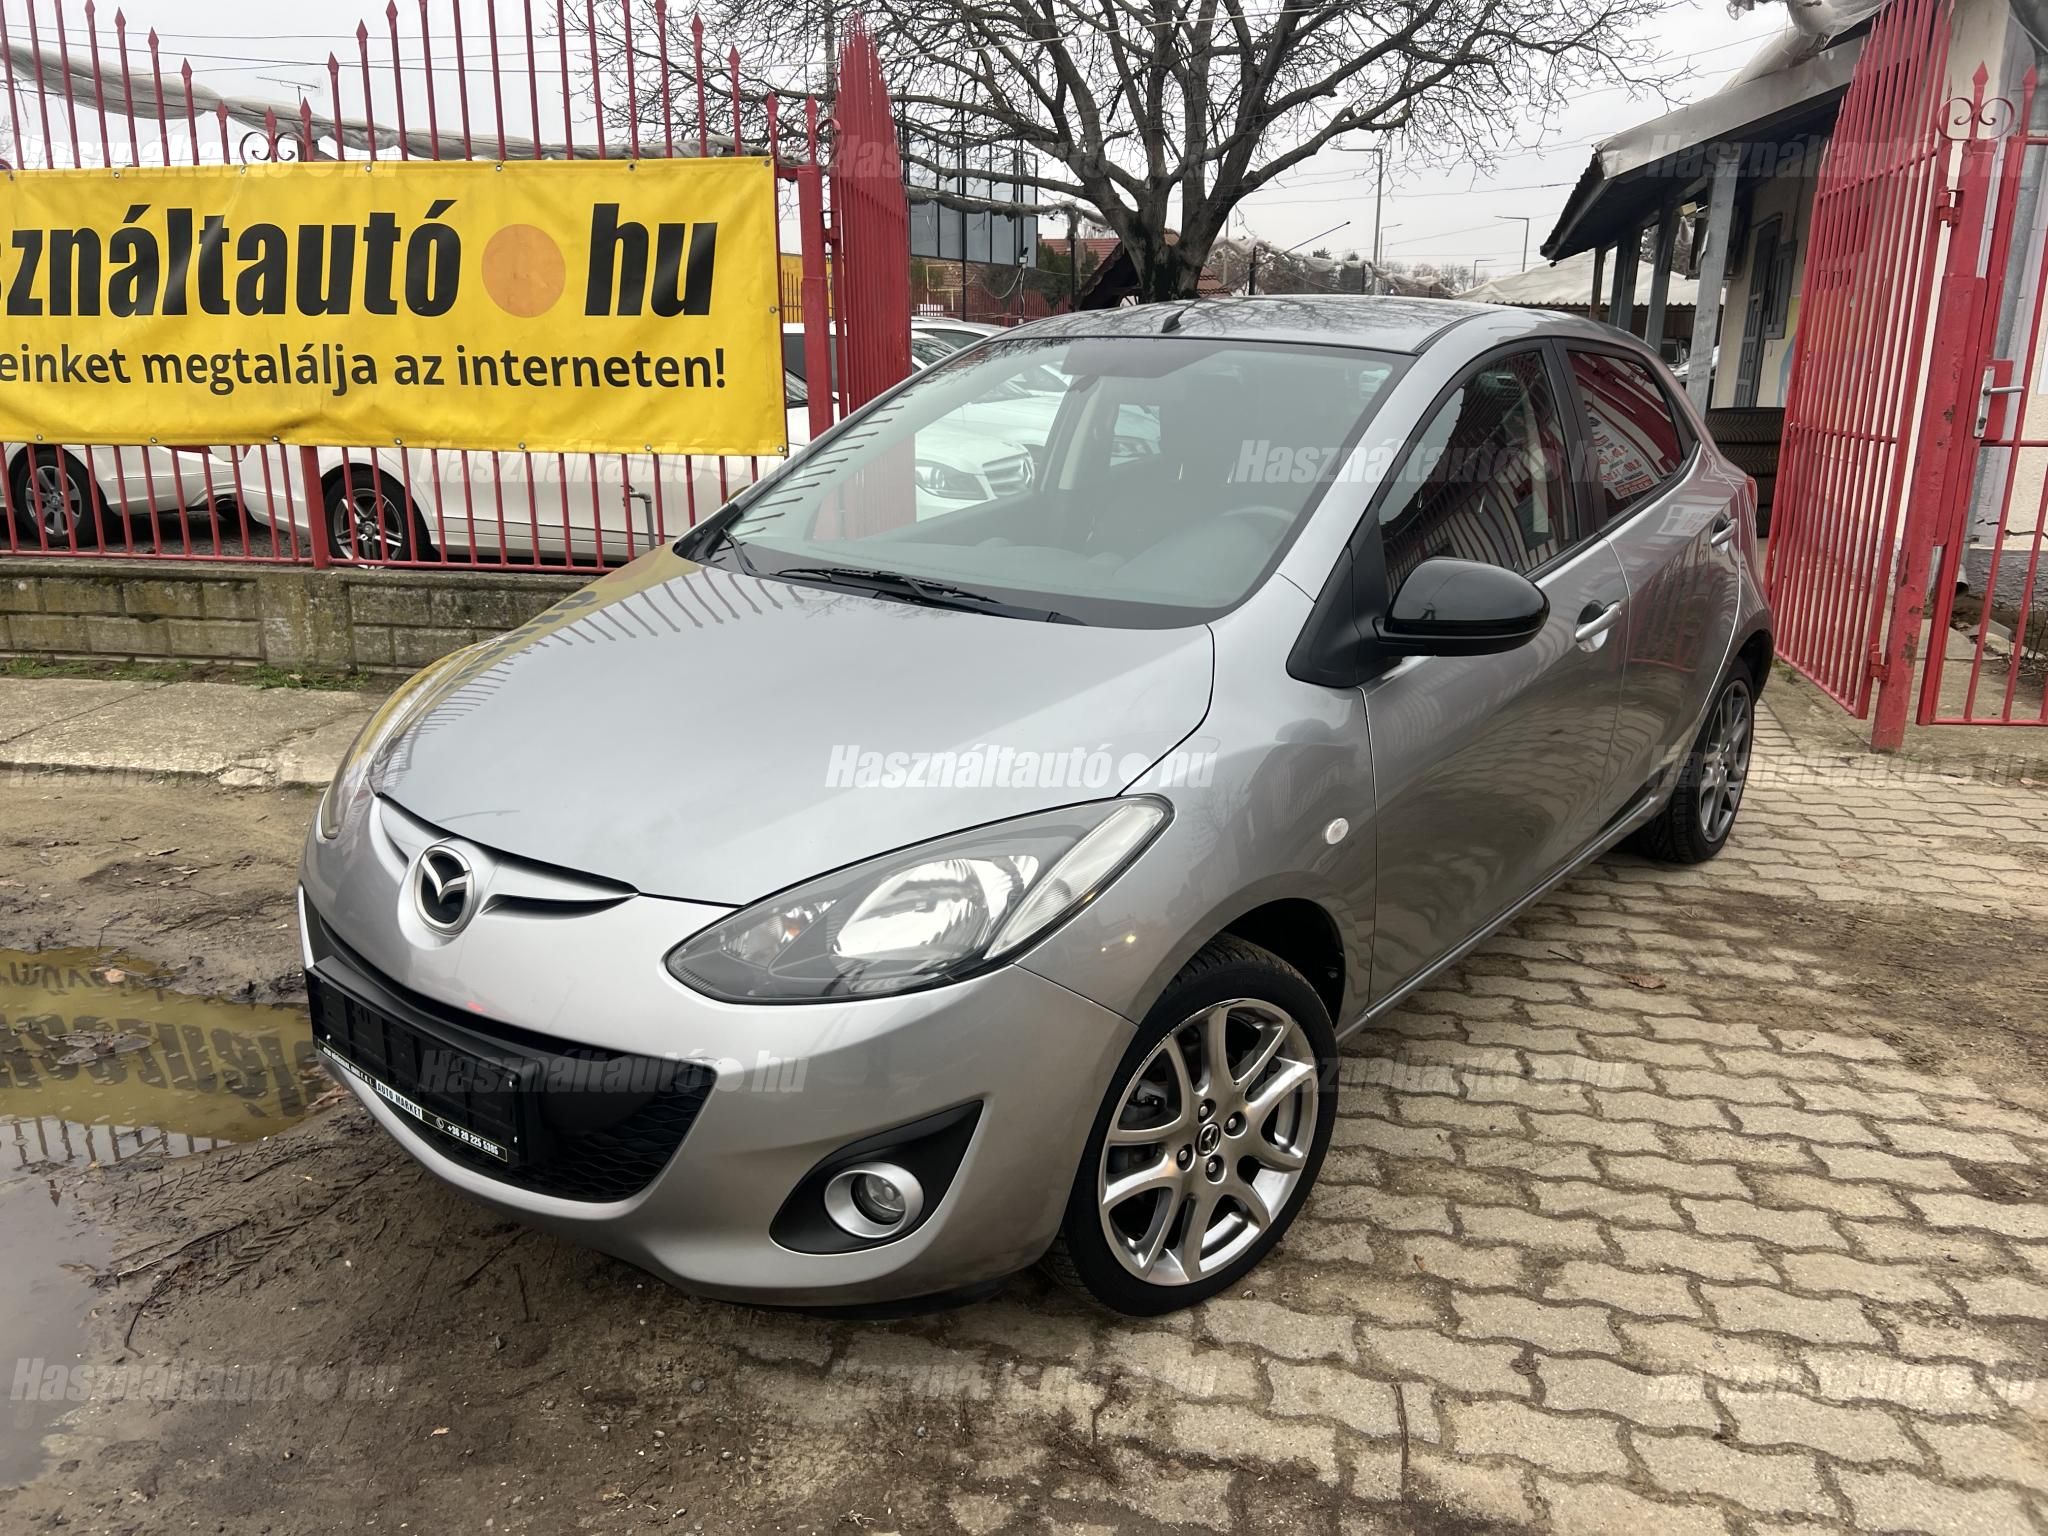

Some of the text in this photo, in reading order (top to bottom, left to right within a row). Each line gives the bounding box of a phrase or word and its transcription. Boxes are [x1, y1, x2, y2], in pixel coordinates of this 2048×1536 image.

[0, 200, 717, 317] ználtautó hu
[142, 343, 377, 396] megtalálja
[394, 355, 445, 386] az
[457, 345, 725, 388] interneten!
[377, 1081, 421, 1118] AUTO MARKET
[470, 1134, 482, 1148] 225
